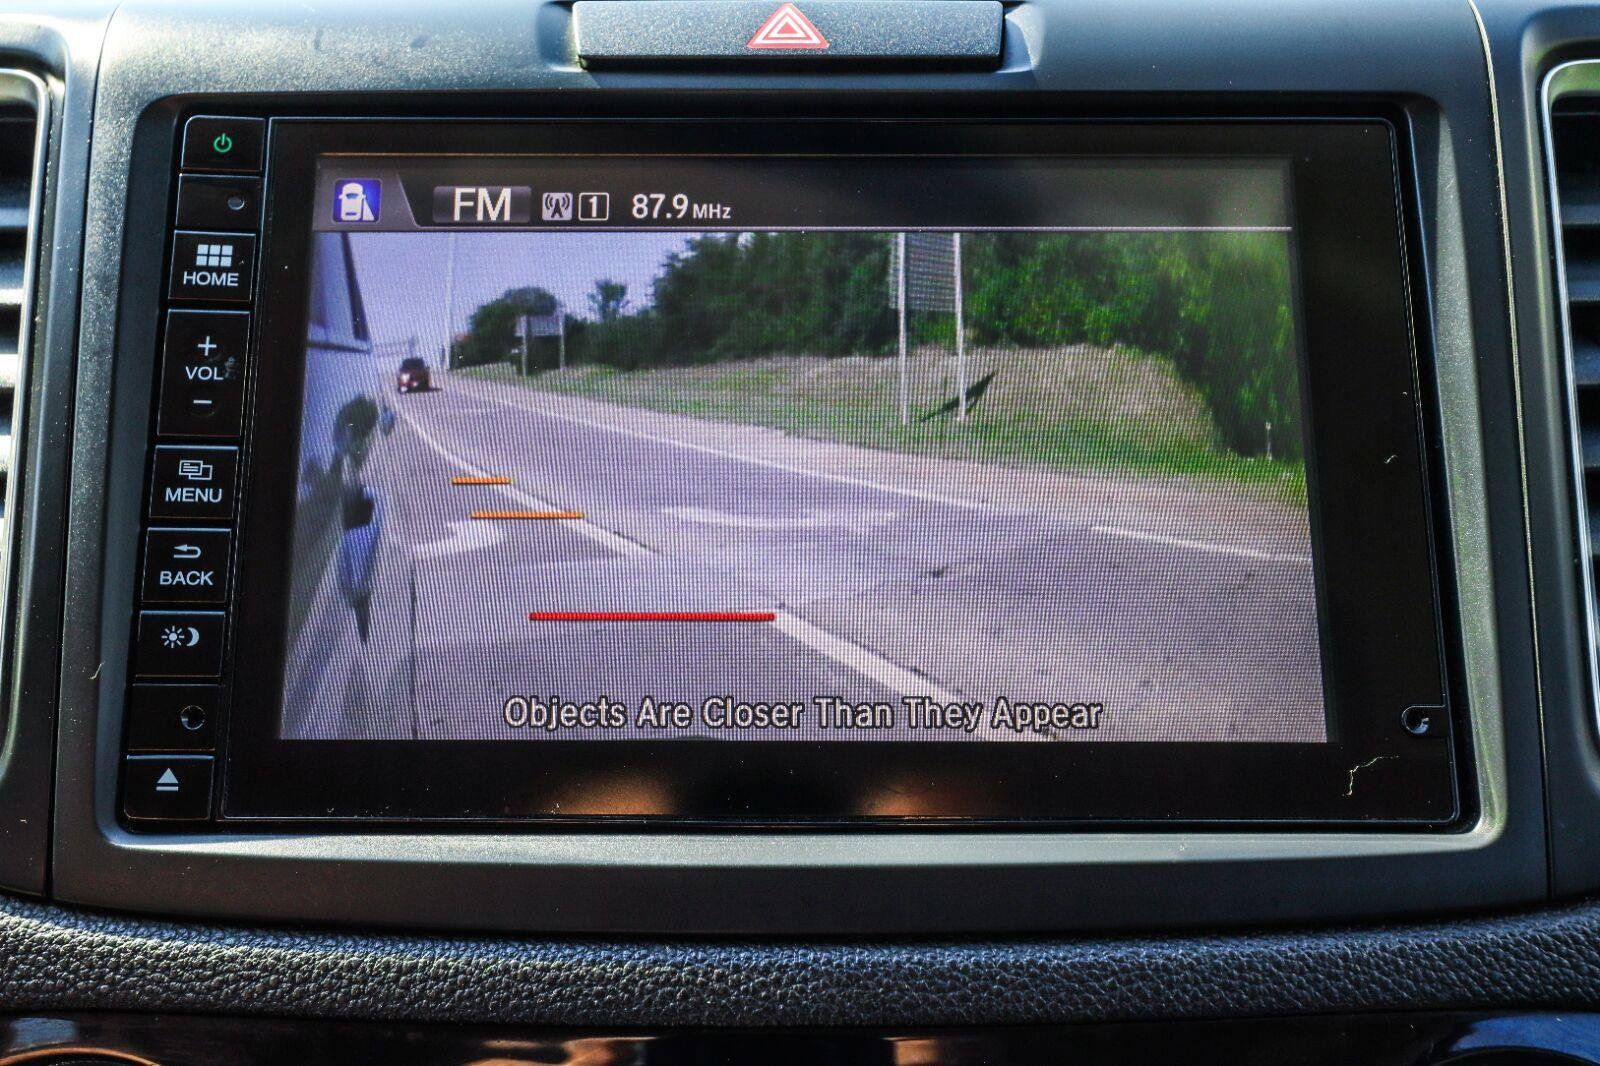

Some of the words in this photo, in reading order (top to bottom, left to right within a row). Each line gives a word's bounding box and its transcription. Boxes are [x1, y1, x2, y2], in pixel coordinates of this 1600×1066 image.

[453, 187, 512, 221] FM
[587, 195, 599, 218] 1
[631, 193, 689, 220] 87.9
[692, 203, 731, 219] MHz
[183, 271, 239, 287] HOME
[185, 366, 223, 381] VOL
[165, 487, 223, 503] MENU
[159, 570, 214, 586] BACK
[504, 697, 627, 730] Objects
[636, 697, 692, 728] Are
[702, 697, 803, 729] Closer
[813, 697, 893, 729] Than
[902, 697, 983, 732] They
[991, 698, 1103, 731] Appear
